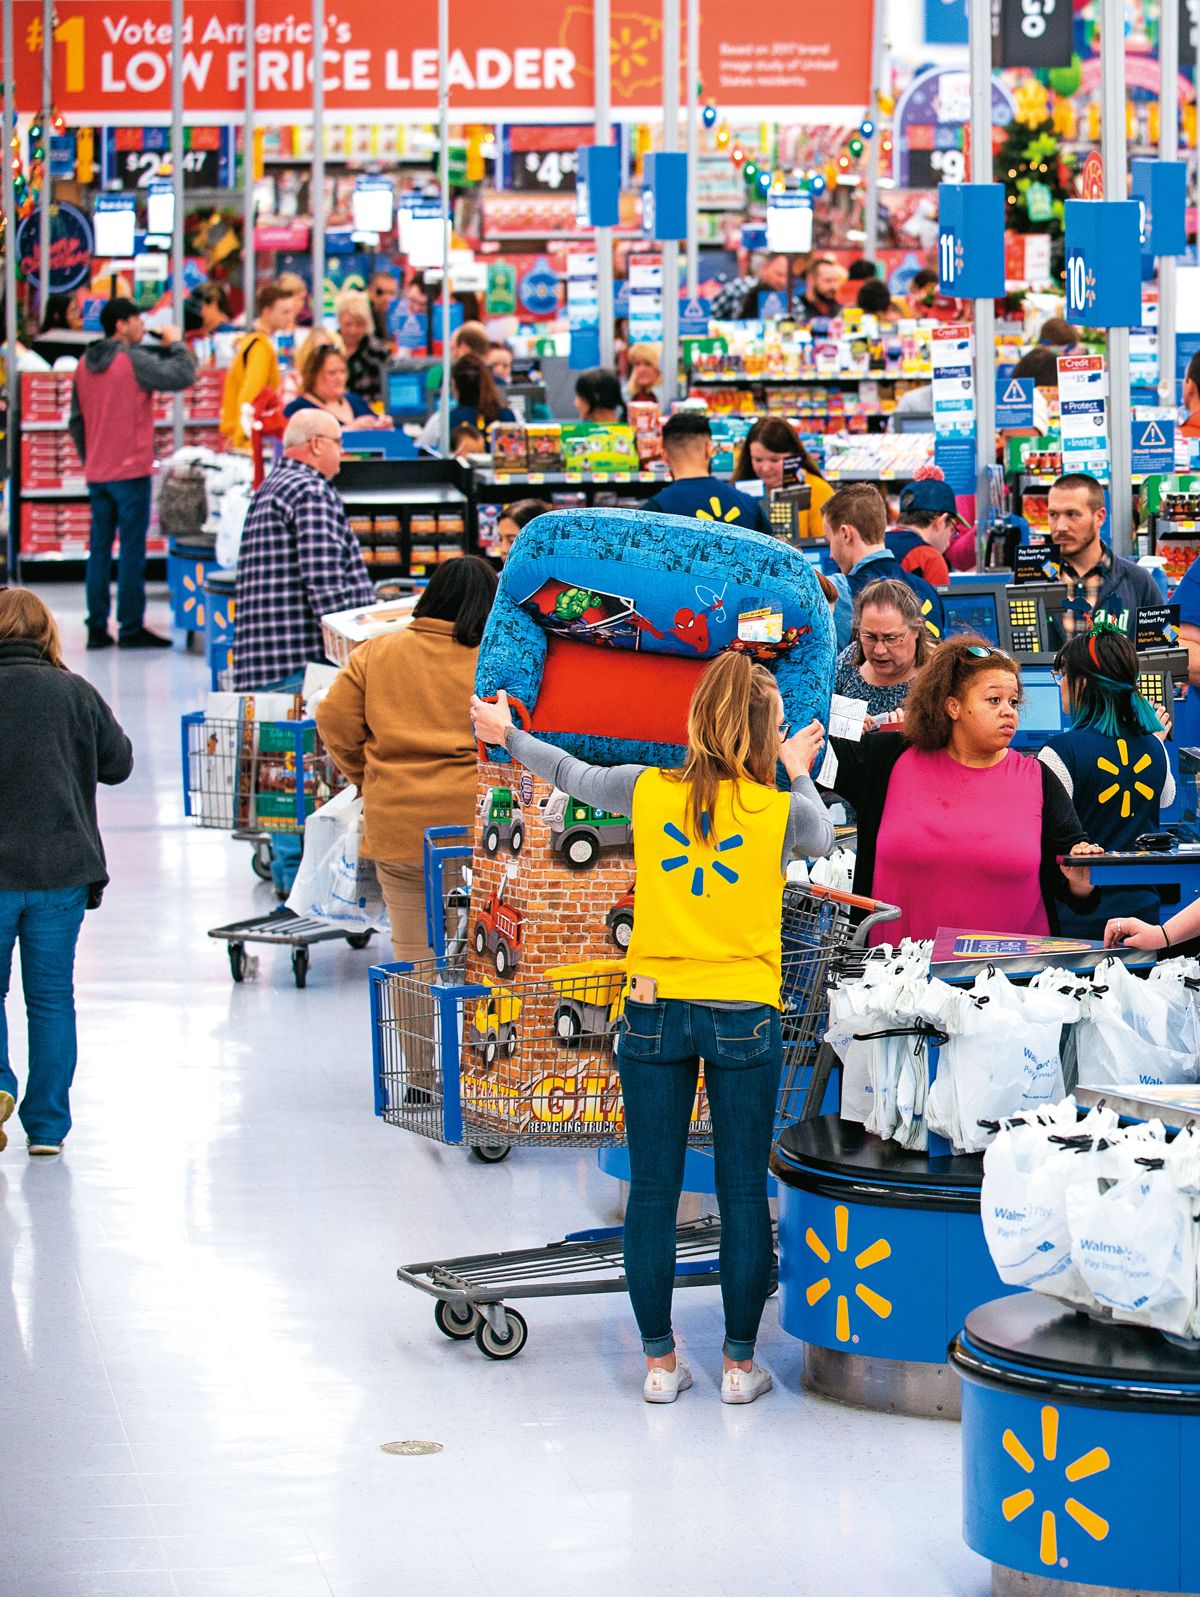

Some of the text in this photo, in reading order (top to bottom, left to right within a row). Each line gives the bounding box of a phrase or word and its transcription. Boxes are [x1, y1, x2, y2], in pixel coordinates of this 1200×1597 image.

[103, 14, 352, 44] Voted Americ's
[720, 42, 752, 56] Based
[102, 48, 576, 92] LOW PRICE LEADER
[940, 234, 954, 283] 11
[1068, 256, 1086, 311] 10
[1064, 358, 1090, 368] Credit
[1069, 401, 1098, 410] Protect
[1071, 437, 1097, 447] Install
[528, 1121, 616, 1132] RECYCLING TRUCK
[1084, 1258, 1100, 1270] Pay
